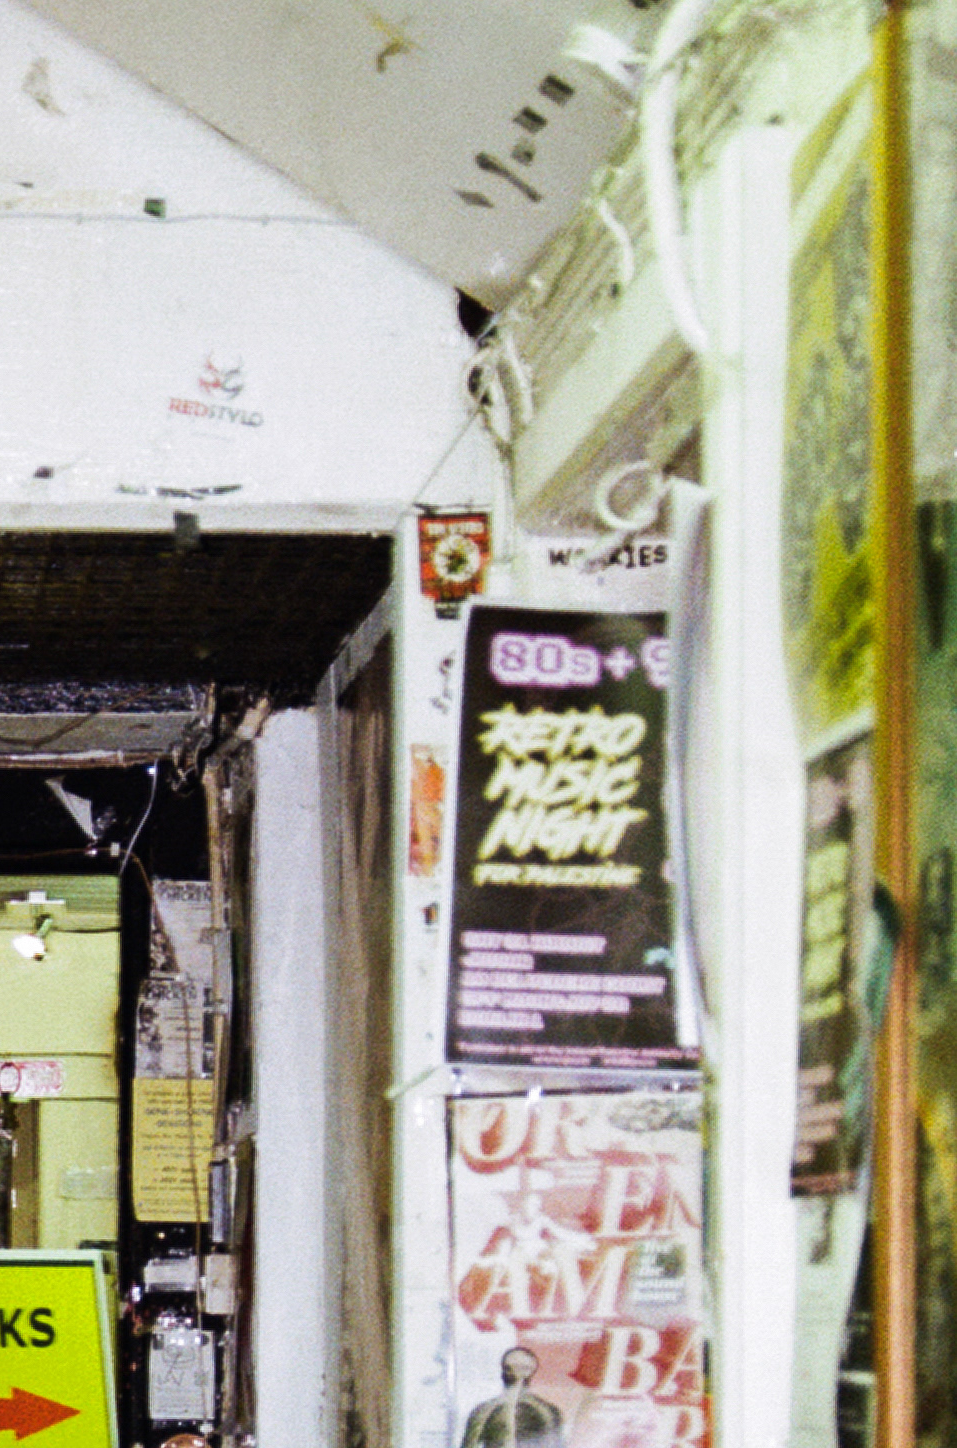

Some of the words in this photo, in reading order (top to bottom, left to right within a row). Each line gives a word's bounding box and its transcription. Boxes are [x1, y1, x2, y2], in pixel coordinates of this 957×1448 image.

[477, 702, 647, 758] RETRO
[484, 753, 643, 811] MUSIC
[477, 803, 649, 862] NIGHT
